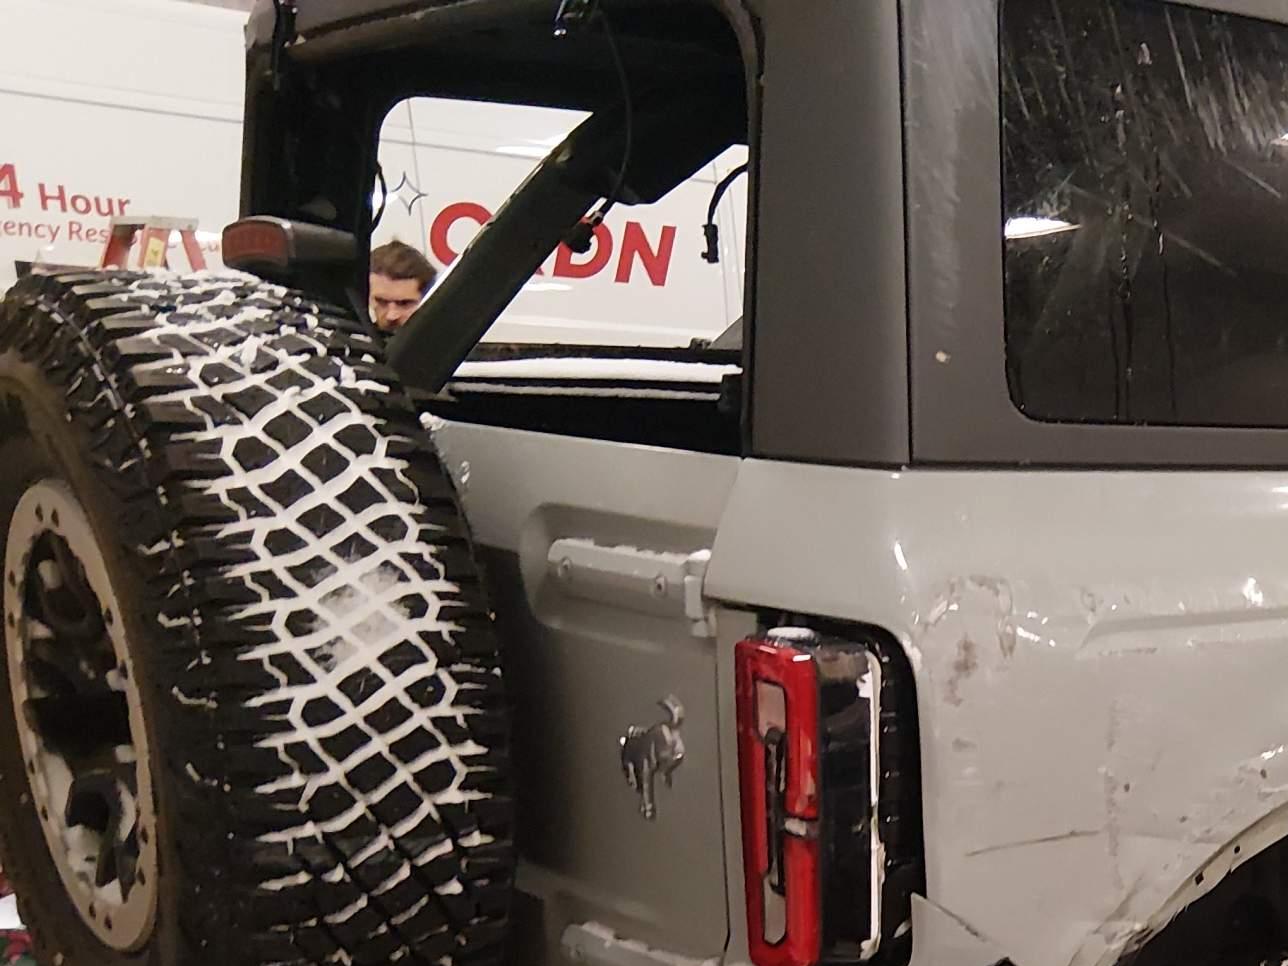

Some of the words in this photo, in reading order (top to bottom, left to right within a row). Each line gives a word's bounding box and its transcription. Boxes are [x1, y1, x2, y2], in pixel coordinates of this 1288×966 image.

[38, 183, 131, 219] Hour
[0, 220, 60, 243] ency
[68, 221, 110, 244] Res
[430, 202, 677, 287] CDN
